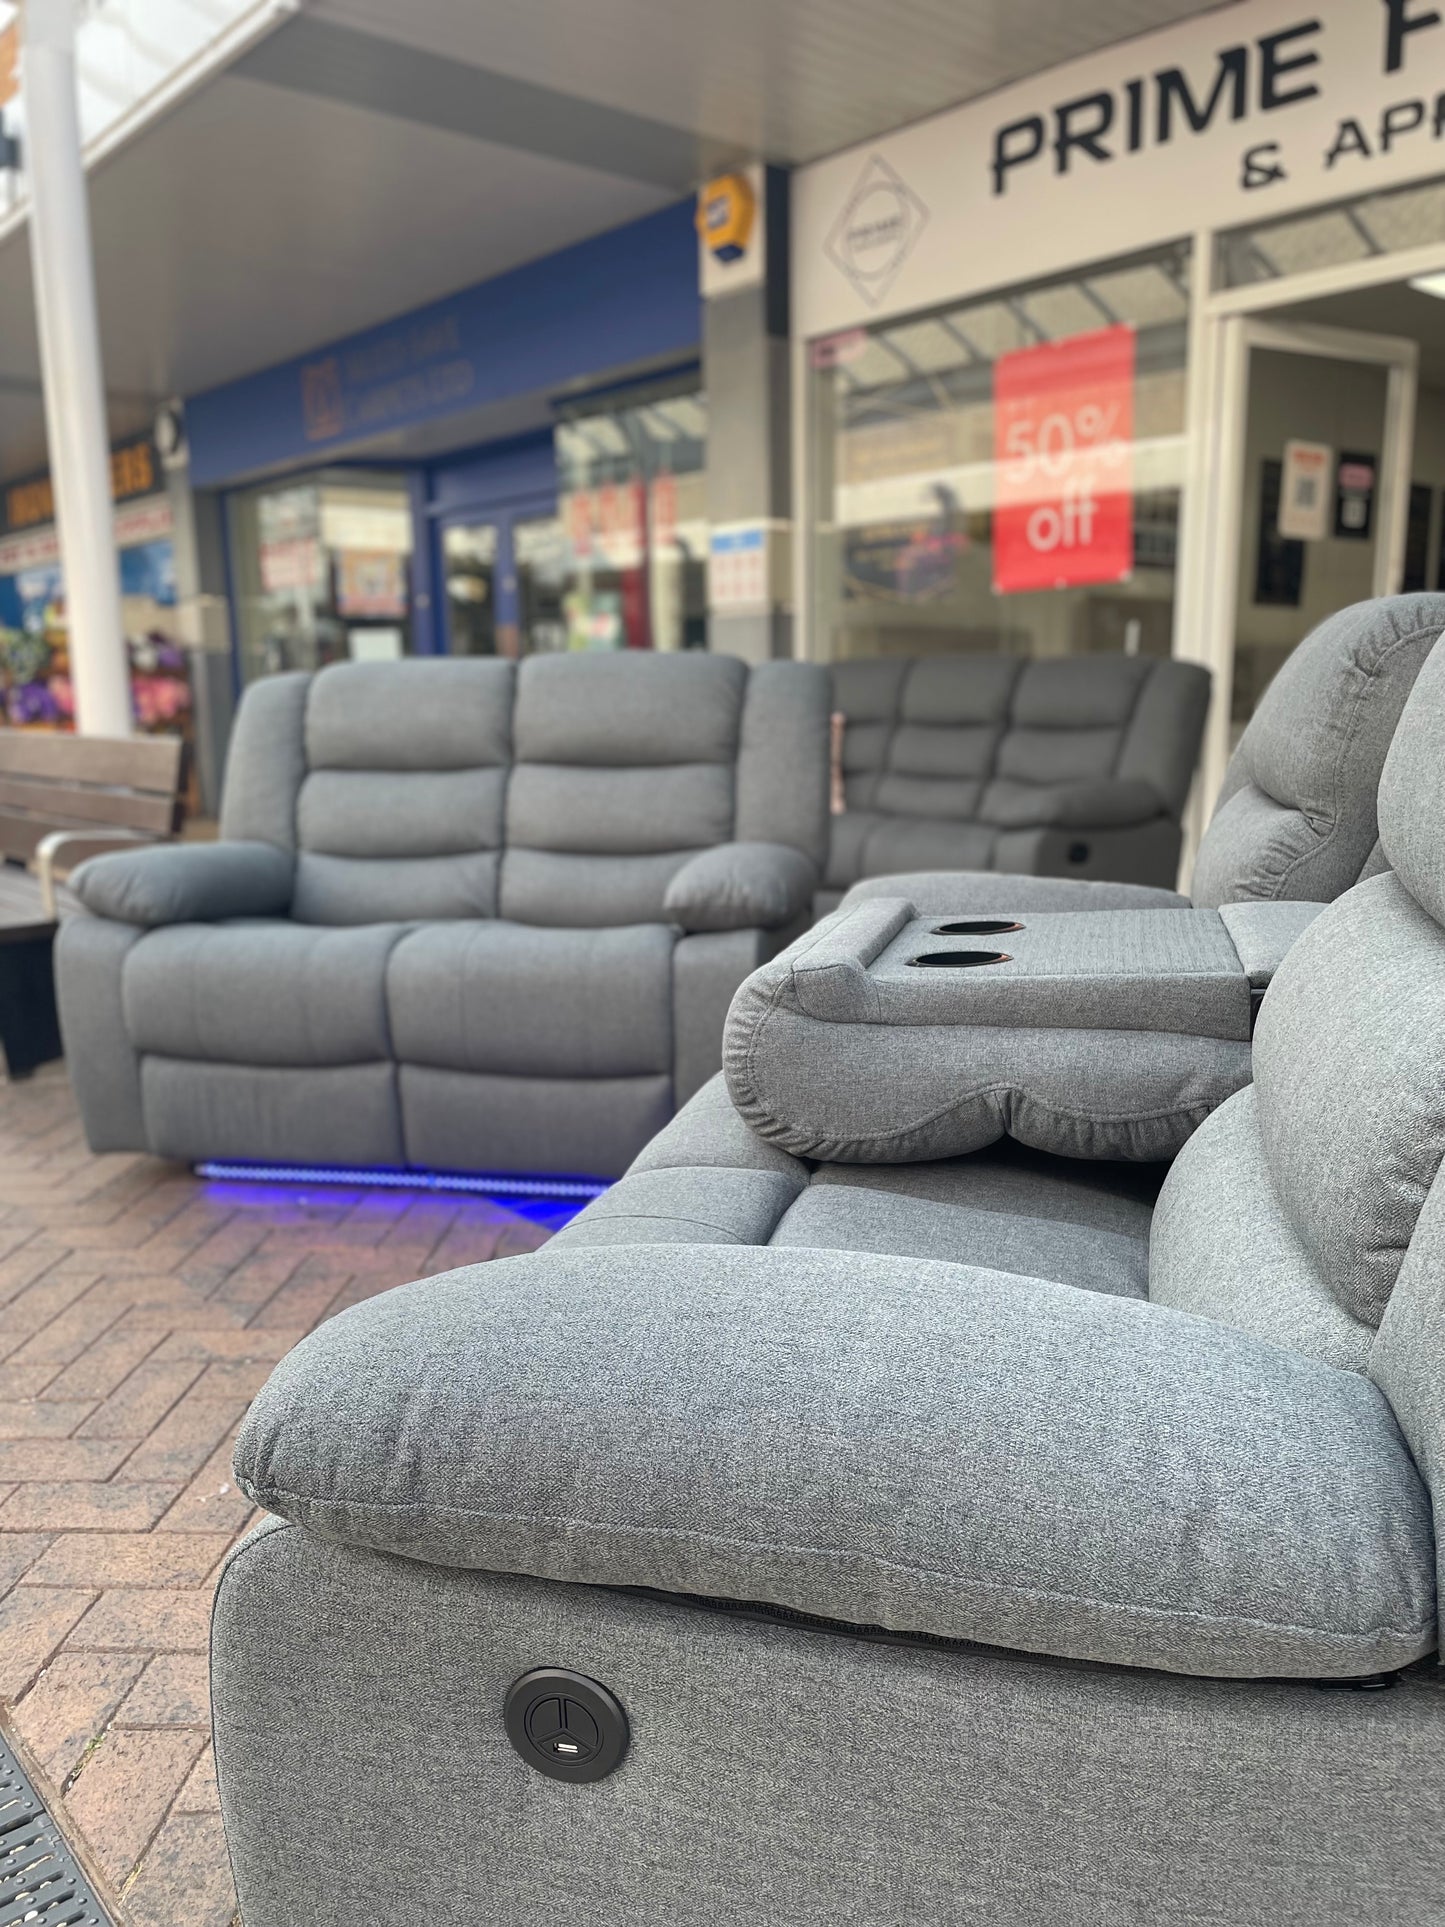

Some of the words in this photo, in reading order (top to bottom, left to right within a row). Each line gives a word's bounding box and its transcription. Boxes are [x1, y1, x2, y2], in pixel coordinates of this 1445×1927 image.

[990, 18, 1323, 196] PRIME
[1241, 142, 1287, 190] &
[1005, 402, 1129, 485] 50%
[1026, 474, 1098, 552] off
